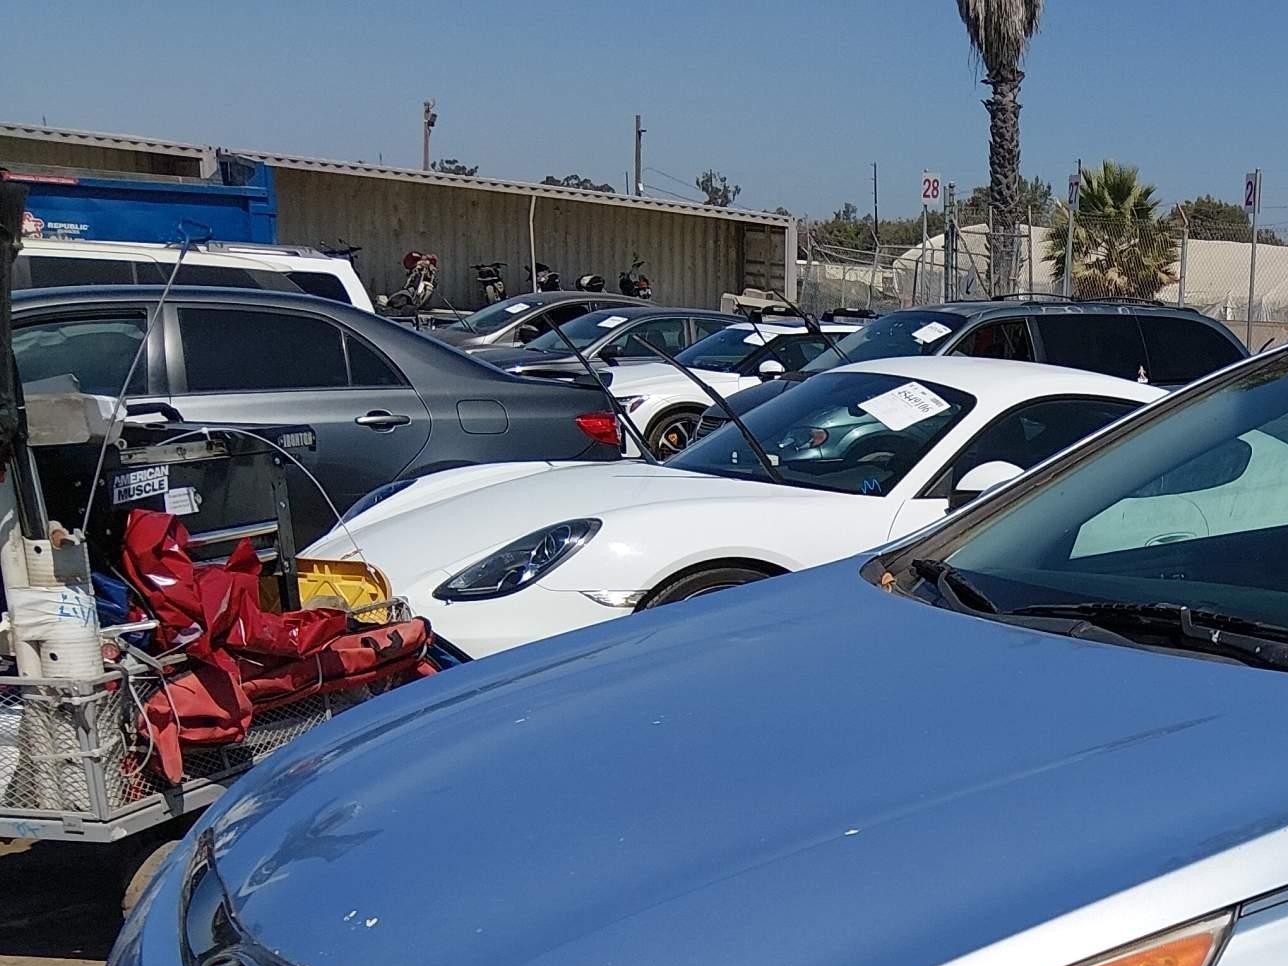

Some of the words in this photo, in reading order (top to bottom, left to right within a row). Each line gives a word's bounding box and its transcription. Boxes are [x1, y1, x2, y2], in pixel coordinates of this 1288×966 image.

[922, 178, 940, 199] 28
[1069, 181, 1079, 205] 27
[113, 465, 169, 488] AMERICAN
[117, 478, 166, 502] MUSCLE
